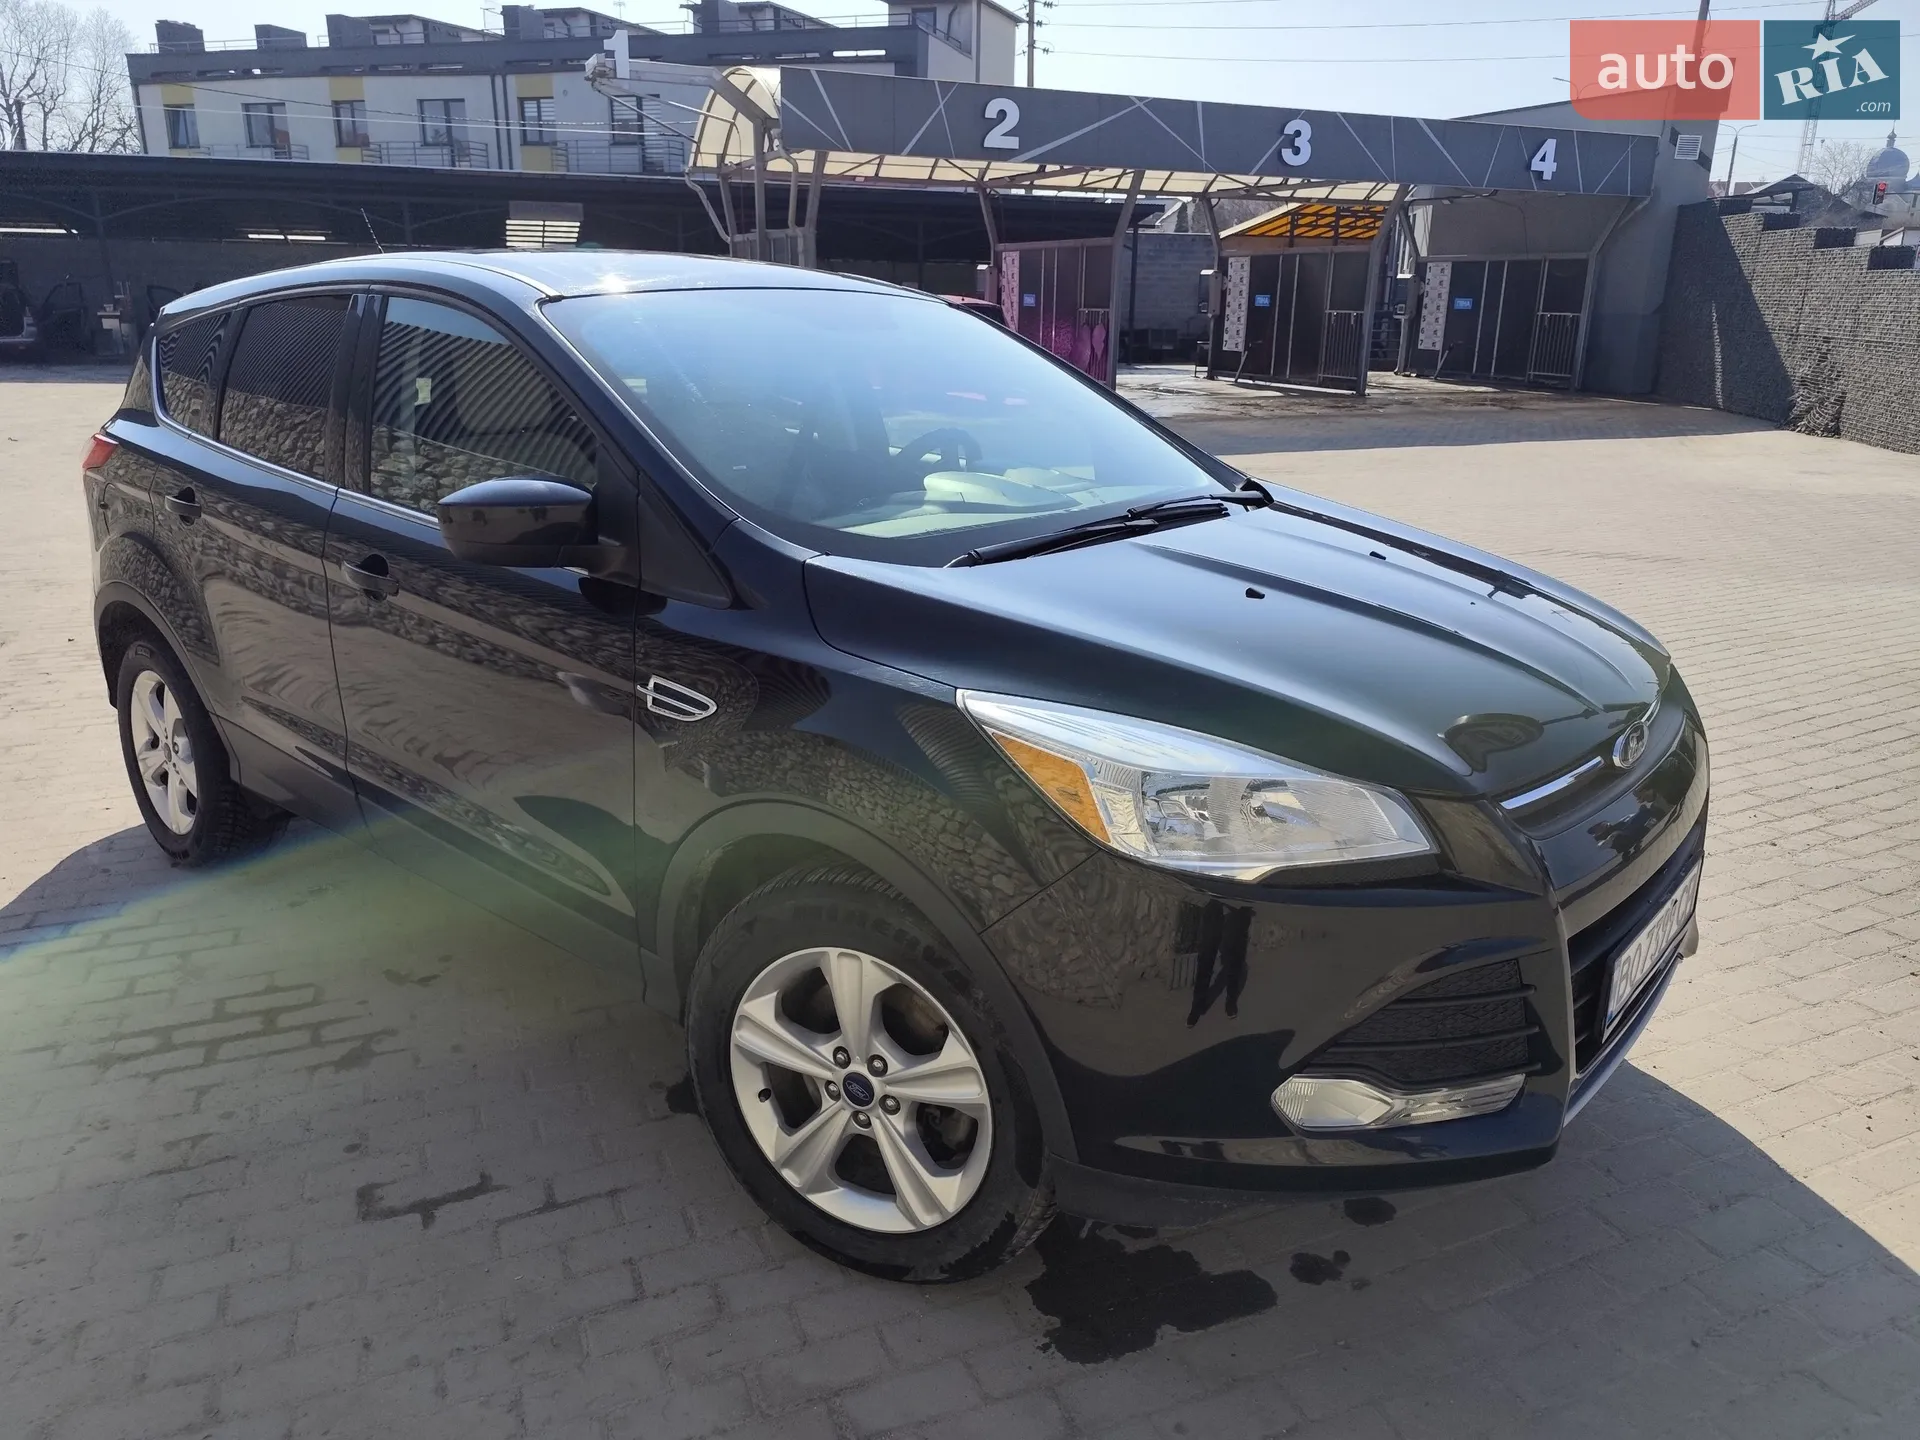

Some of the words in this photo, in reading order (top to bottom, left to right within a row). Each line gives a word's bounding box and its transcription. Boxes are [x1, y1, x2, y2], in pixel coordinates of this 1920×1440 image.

[603, 29, 630, 88] 1
[983, 97, 1020, 150] 2
[1281, 119, 1312, 167] 3
[1530, 138, 1557, 181] 4
[848, 1083, 866, 1099] Ford
